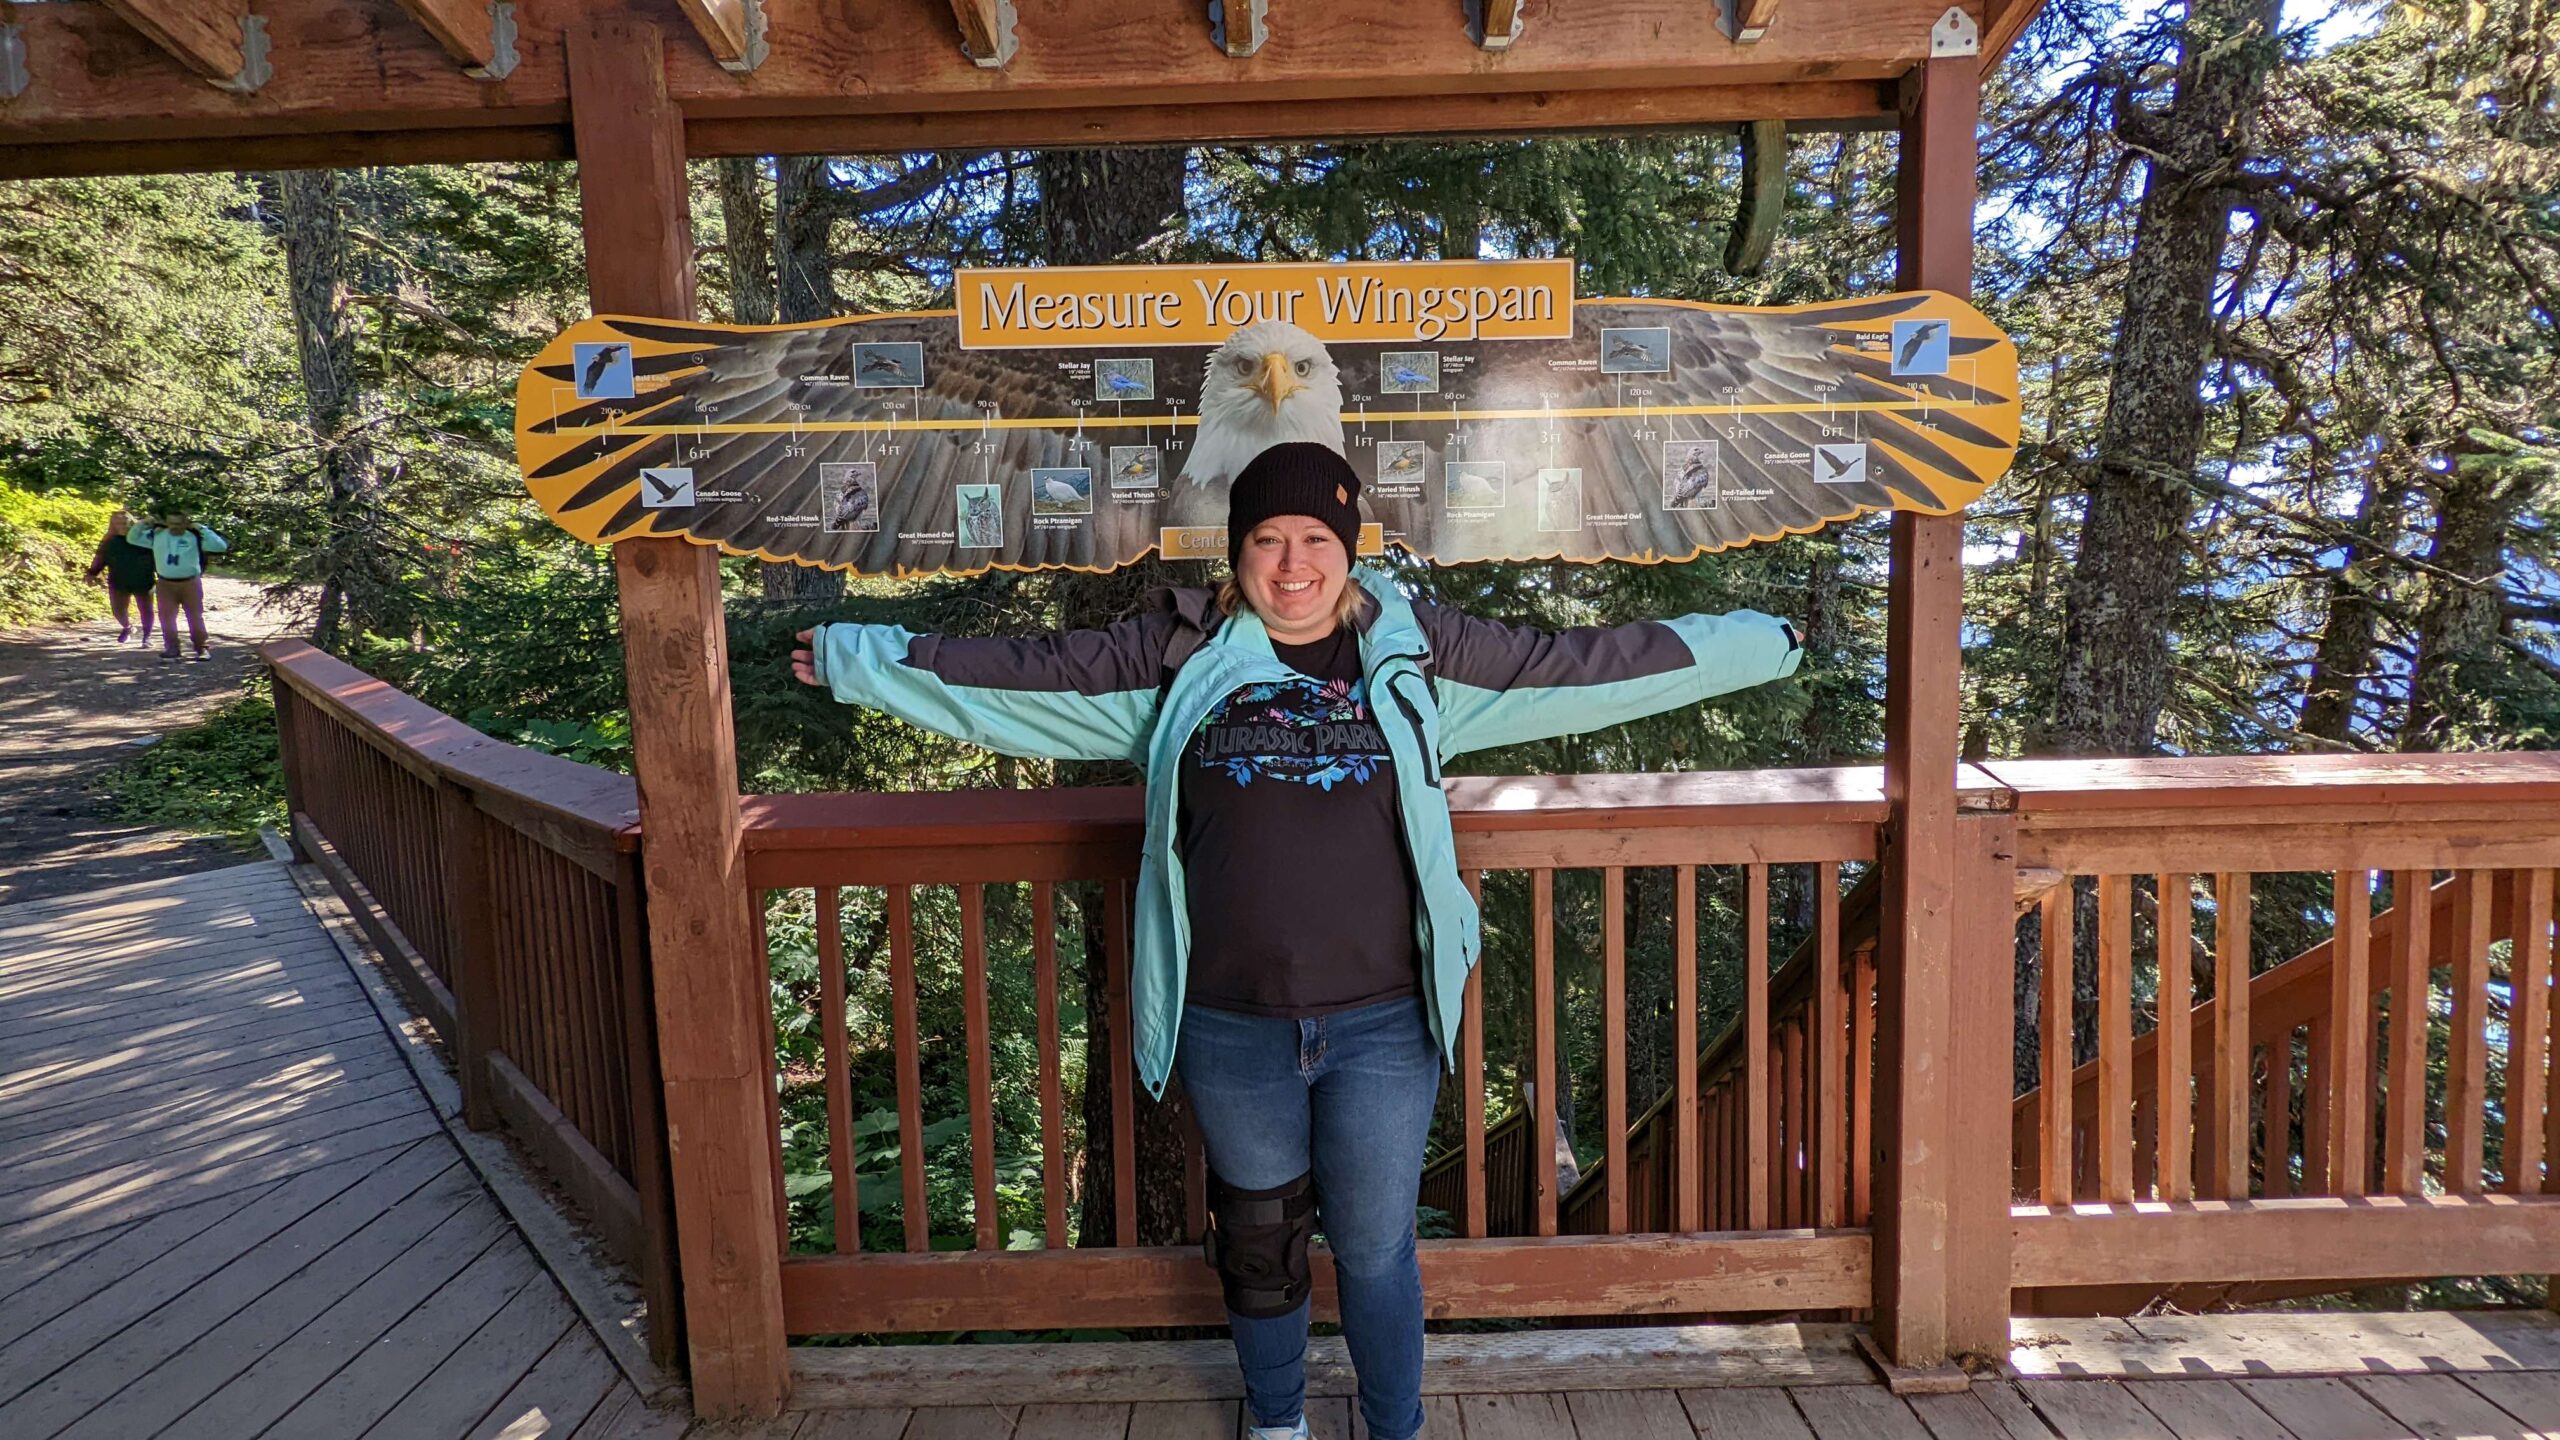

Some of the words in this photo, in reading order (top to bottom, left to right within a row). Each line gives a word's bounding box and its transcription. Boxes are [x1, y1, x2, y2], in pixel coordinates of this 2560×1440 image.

[979, 281, 1182, 332] Measure
[1196, 277, 1304, 327] Your
[1316, 275, 1555, 341] Wingspan
[1872, 333, 1889, 342] Eagle
[1058, 362, 1080, 370] Stellar
[1080, 362, 1091, 370] Jay
[800, 374, 829, 382] Common
[1722, 386, 1733, 394] 150
[1814, 384, 1826, 392] 180
[1906, 382, 1919, 390] 210
[1352, 394, 1361, 402] 30
[1630, 388, 1642, 397] 120
[695, 405, 707, 413] 180
[789, 403, 800, 411] 150
[883, 402, 895, 410] 120
[977, 400, 987, 408] 90
[601, 407, 613, 415] 210
[1728, 426, 1735, 439] 5
[1738, 430, 1750, 439] FT
[1822, 425, 1830, 437] 6
[1832, 427, 1844, 437] FT
[1915, 421, 1922, 433] 7
[1355, 434, 1359, 447] 1
[1362, 437, 1373, 447] FT
[1447, 433, 1454, 445] 2
[1457, 435, 1468, 444] FT
[1541, 431, 1548, 444] 3
[1551, 434, 1561, 443] FT
[1633, 429, 1641, 441] 4
[1645, 431, 1657, 441] FT
[878, 444, 886, 455] 4
[889, 446, 900, 455] FT
[974, 442, 980, 454] 3
[984, 444, 996, 454] FT
[1068, 439, 1076, 451] 2
[1080, 441, 1092, 450] FT
[1164, 438, 1169, 450] 1
[1172, 441, 1184, 450] FT
[689, 447, 697, 459] 6
[699, 450, 710, 459] FT
[785, 445, 792, 457] 5
[794, 448, 806, 457] FT
[594, 452, 601, 463] 7
[1398, 485, 1420, 493] Thrush
[1133, 491, 1155, 499] Thrush
[766, 515, 800, 523] Red-Tailed
[1179, 532, 1229, 549] Cente
[1205, 725, 1312, 758] JURASSIC
[1313, 723, 1386, 754] PARK
